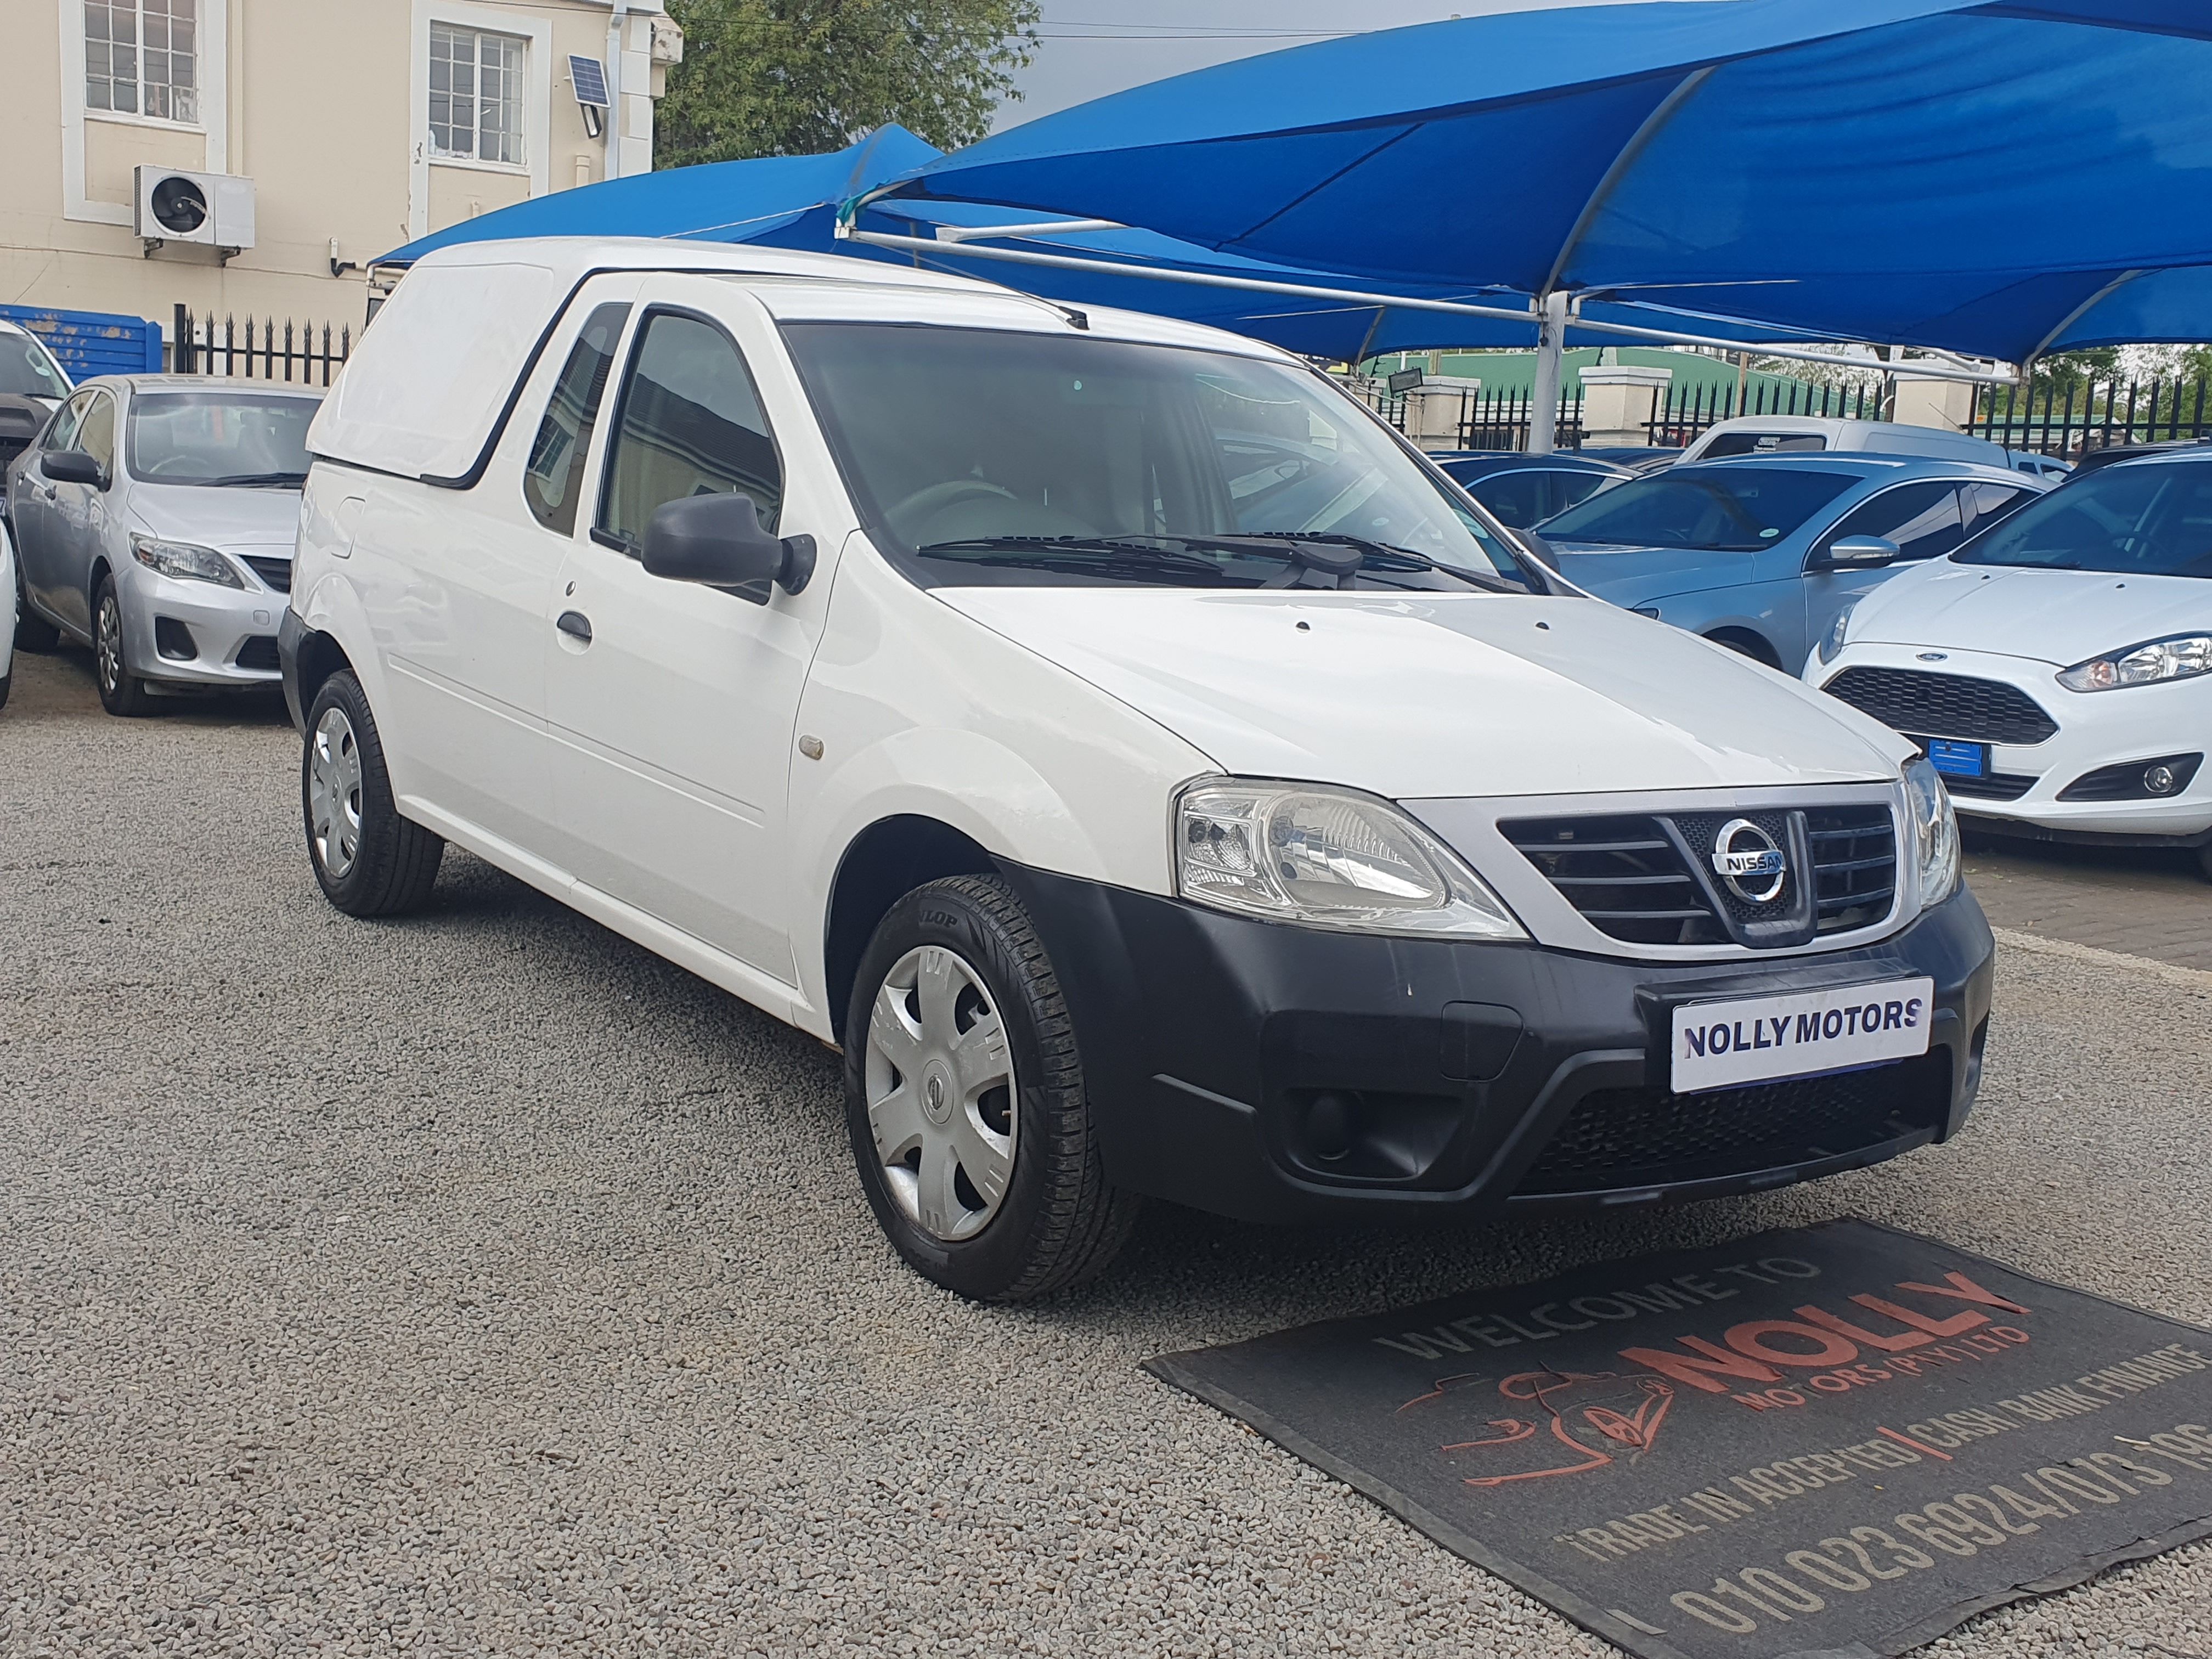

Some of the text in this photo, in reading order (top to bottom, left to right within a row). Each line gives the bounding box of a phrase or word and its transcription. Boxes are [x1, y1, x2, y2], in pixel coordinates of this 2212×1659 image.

[1726, 855, 1782, 871] NISSAN
[1684, 998, 1923, 1059] NOLLY MOTORS
[1372, 1257, 1822, 1361] WELCOME TO
[1616, 1271, 2032, 1394] NOLLY
[1551, 1503, 1711, 1562] TRADE
[1680, 1486, 1755, 1523] IN
[1729, 1438, 1923, 1505] ACCEPTED
[2075, 1342, 2212, 1399] FINANCE
[1669, 1566, 1825, 1633] 010
[1784, 1525, 1936, 1593] 023
[1894, 1452, 2174, 1556] 6924/073
